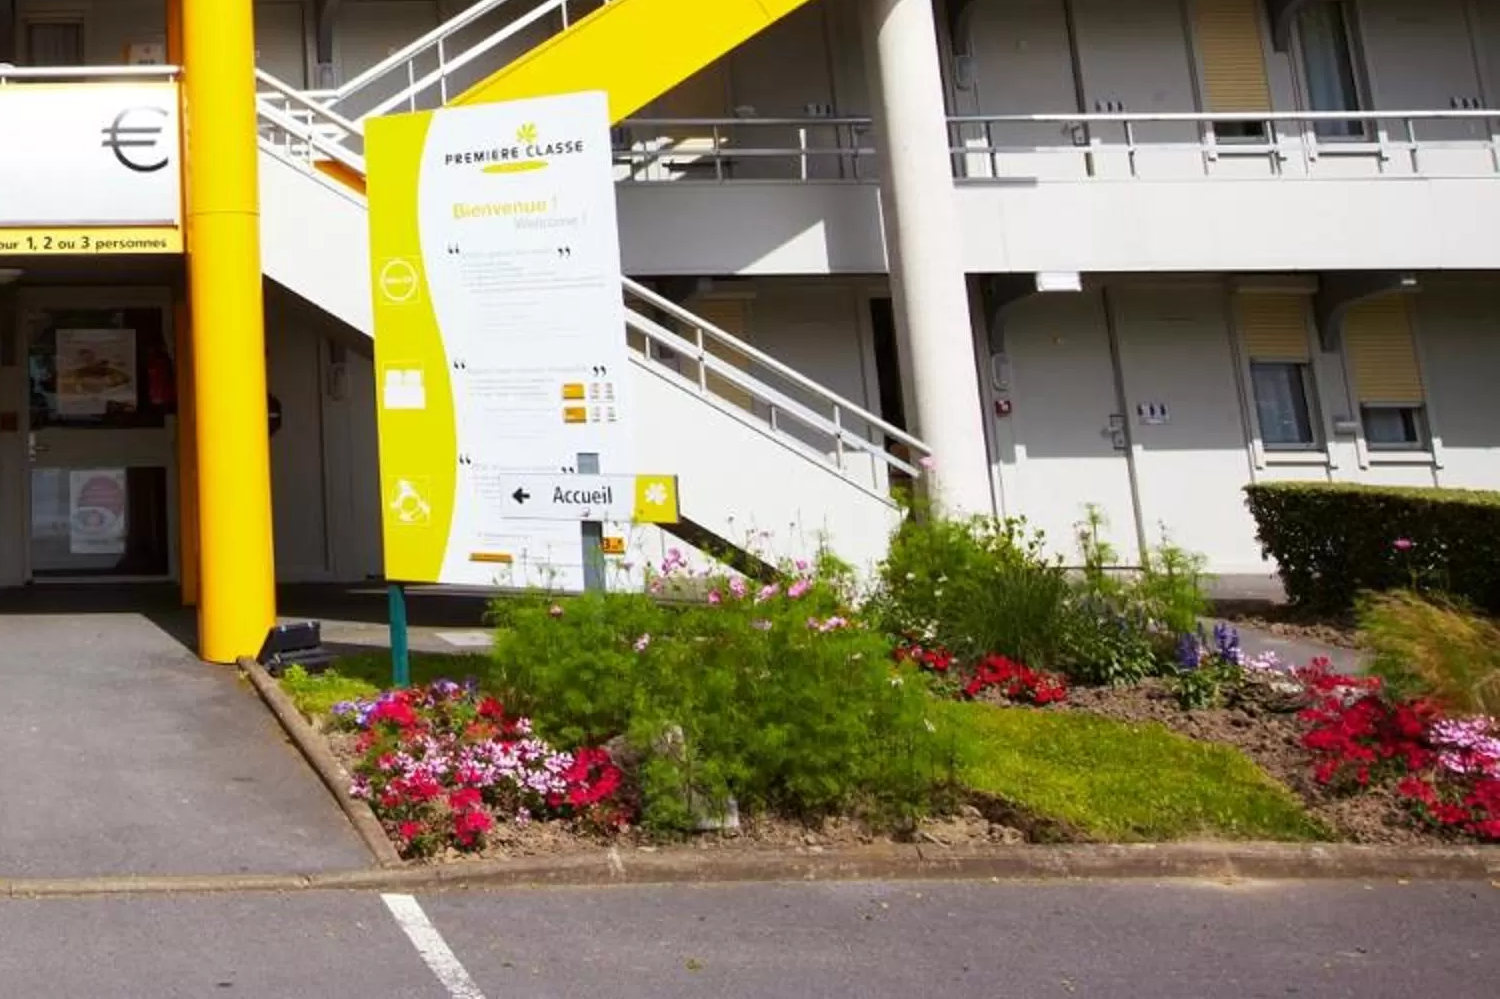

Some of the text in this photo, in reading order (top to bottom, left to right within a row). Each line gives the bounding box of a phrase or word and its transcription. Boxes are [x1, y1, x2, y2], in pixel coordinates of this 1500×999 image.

[444, 140, 584, 165] PREMIERE CLASSE
[452, 200, 548, 219] Bienvenue
[42, 236, 54, 250] 2
[57, 239, 76, 250] ou
[80, 236, 91, 250] 3
[95, 239, 167, 251] personnes
[552, 485, 613, 505] Accueil
